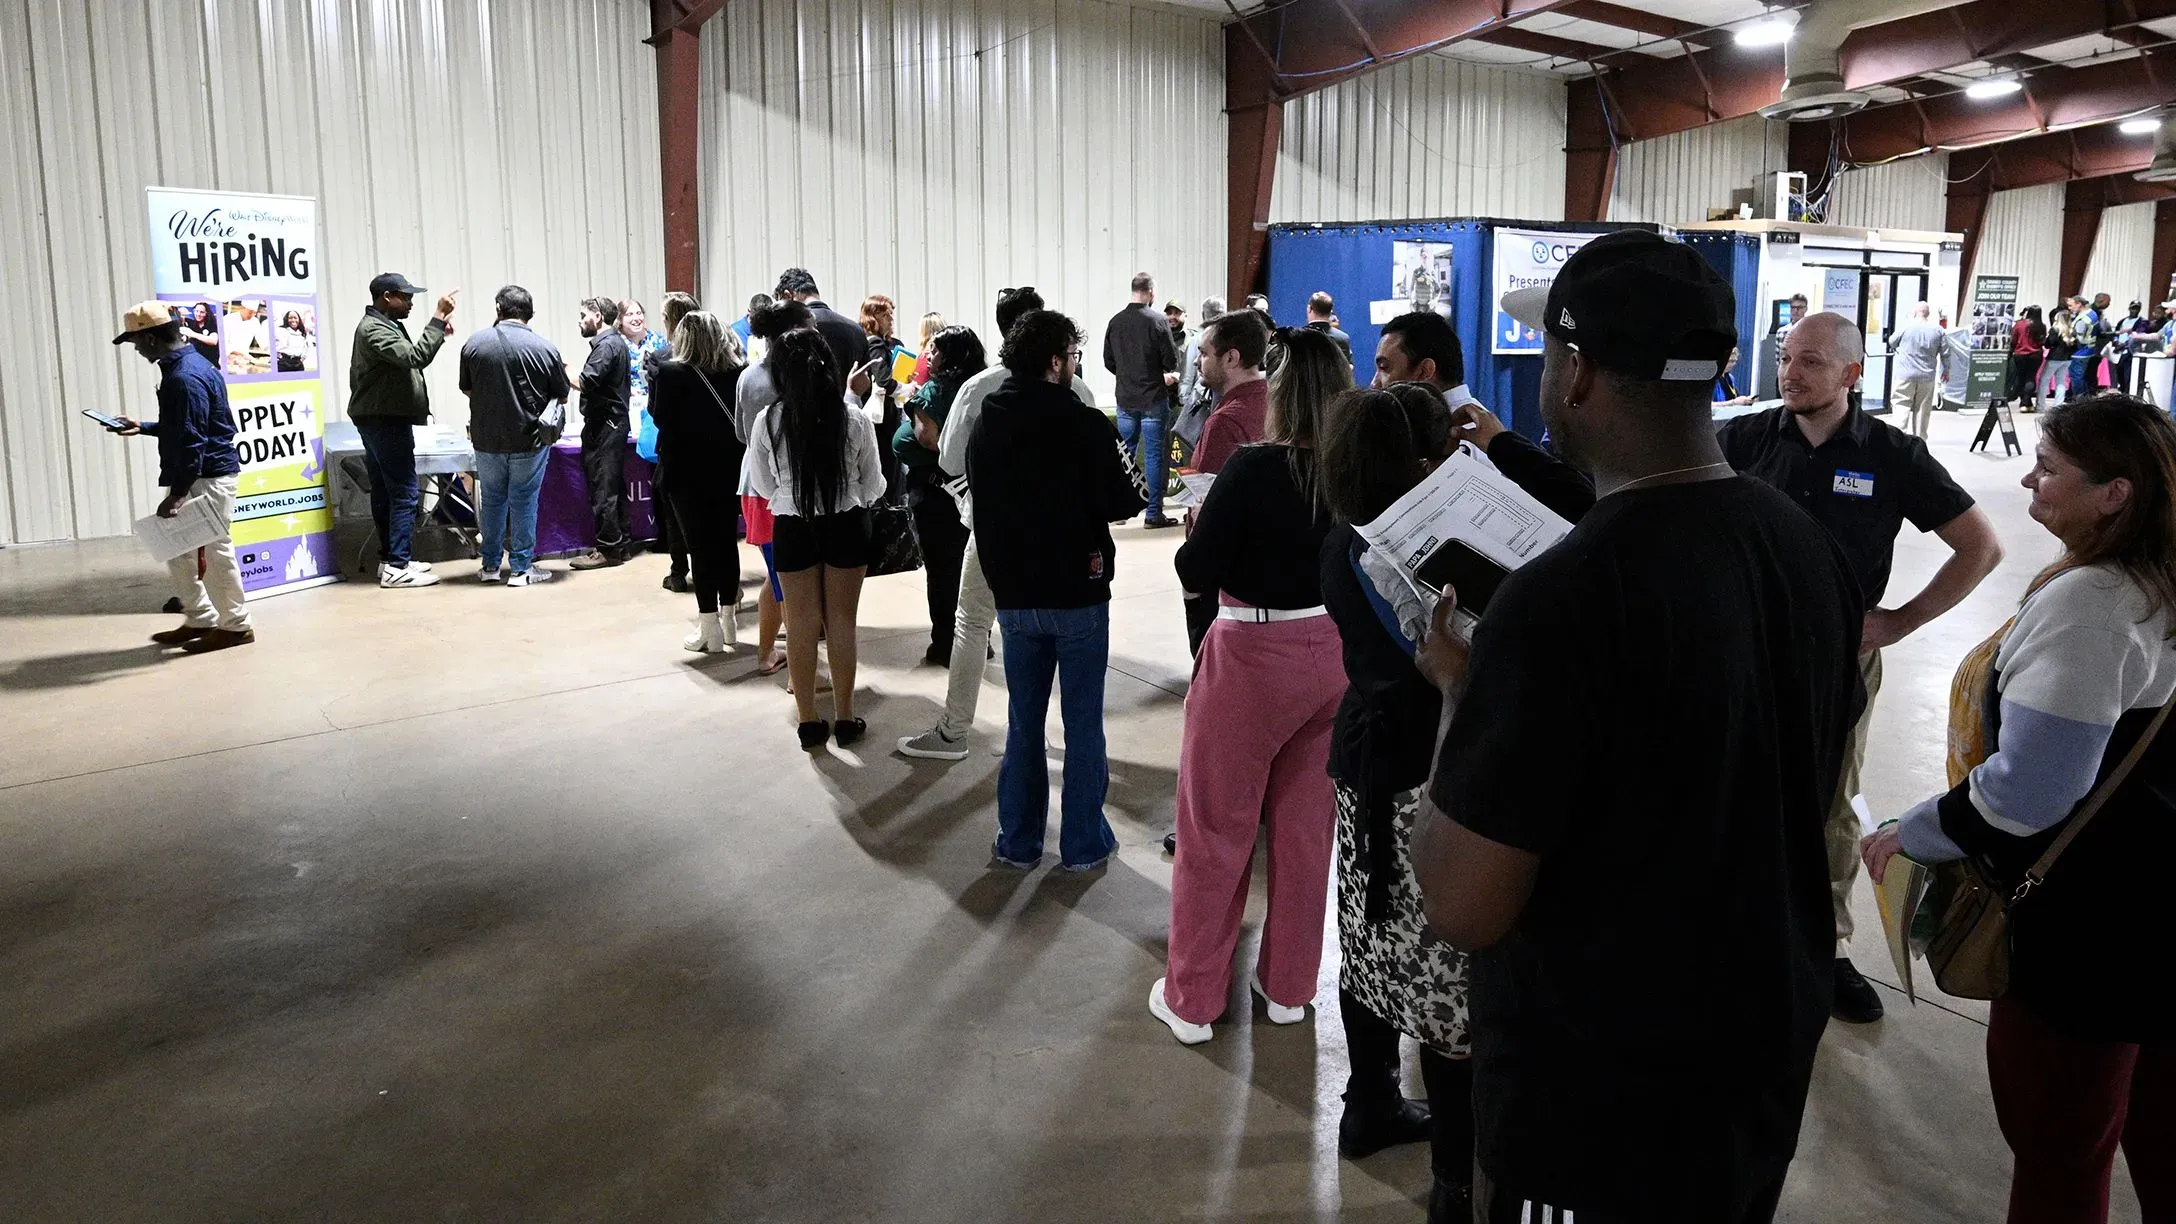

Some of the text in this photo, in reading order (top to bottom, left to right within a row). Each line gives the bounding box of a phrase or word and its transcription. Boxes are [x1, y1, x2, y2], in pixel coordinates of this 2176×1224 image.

[169, 208, 238, 240] We're
[238, 401, 296, 433] PPLY
[236, 431, 307, 465] ODAY!
[1838, 478, 1858, 488] ASL
[1407, 553, 1421, 568] PAPA
